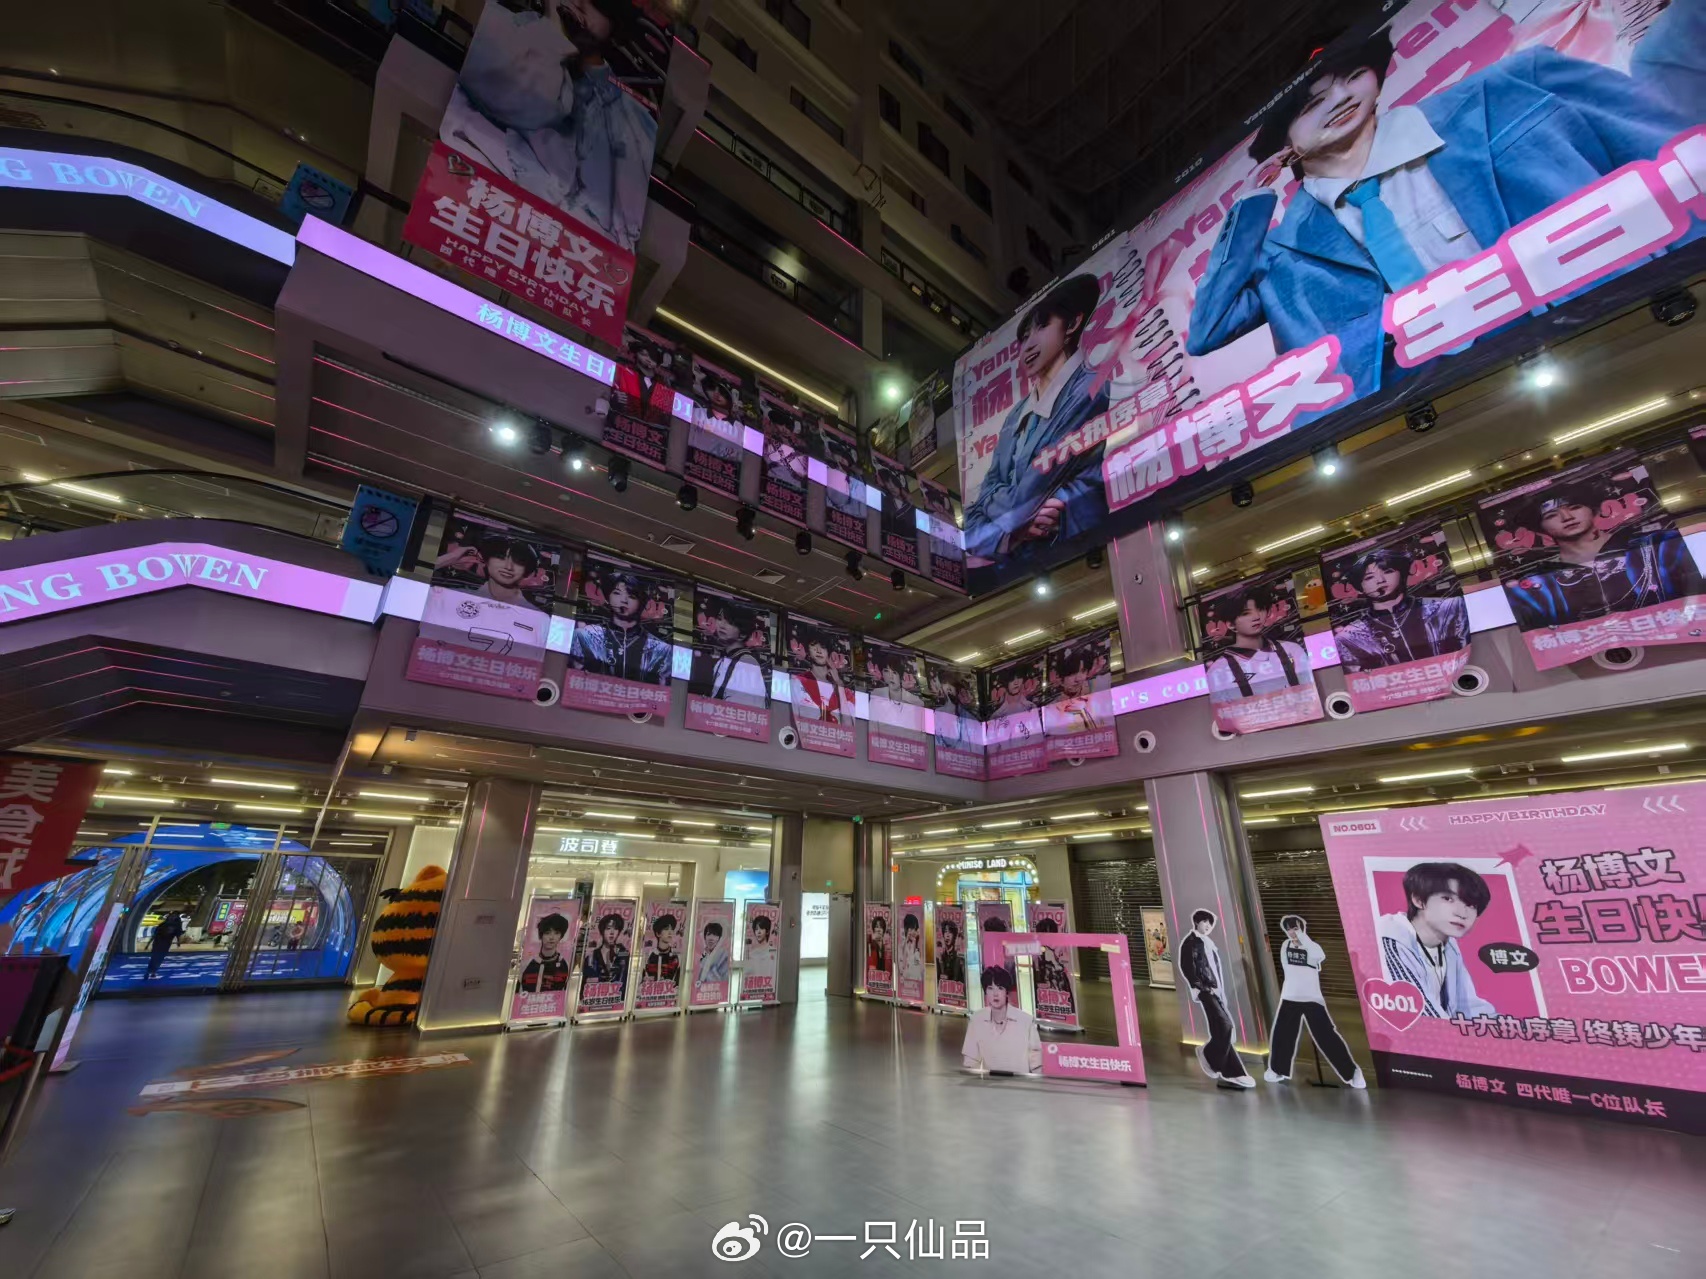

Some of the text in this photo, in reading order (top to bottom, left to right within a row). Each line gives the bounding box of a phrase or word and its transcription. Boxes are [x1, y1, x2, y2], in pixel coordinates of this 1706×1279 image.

[48, 162, 207, 218] BOWEN
[466, 176, 604, 275] 杨博文
[429, 195, 616, 317] 生日快乐
[445, 236, 590, 318] HAPPY BIRTHDAY
[972, 340, 1022, 382] Yang
[1105, 338, 1349, 508] 杨博文
[97, 553, 268, 591] BOWEN
[417, 646, 537, 681] 杨博文生日快乐
[569, 674, 668, 703] 杨博文生日快乐
[690, 699, 769, 726] 杨博文生日快乐
[1333, 822, 1377, 833] NO.0601
[1449, 804, 1607, 825] HAPPY BIRTHDAY
[559, 837, 619, 855] 波司登
[987, 858, 1007, 868] LAND
[1539, 846, 1686, 895] 杨博文
[1030, 905, 1065, 927] Yang
[1489, 949, 1530, 967] 博文
[1370, 991, 1419, 1014] 0601
[1450, 1012, 1706, 1052] 十六执序章 终铸少年
[1455, 1072, 1668, 1119] 杨博文 四代唯一C位队长
